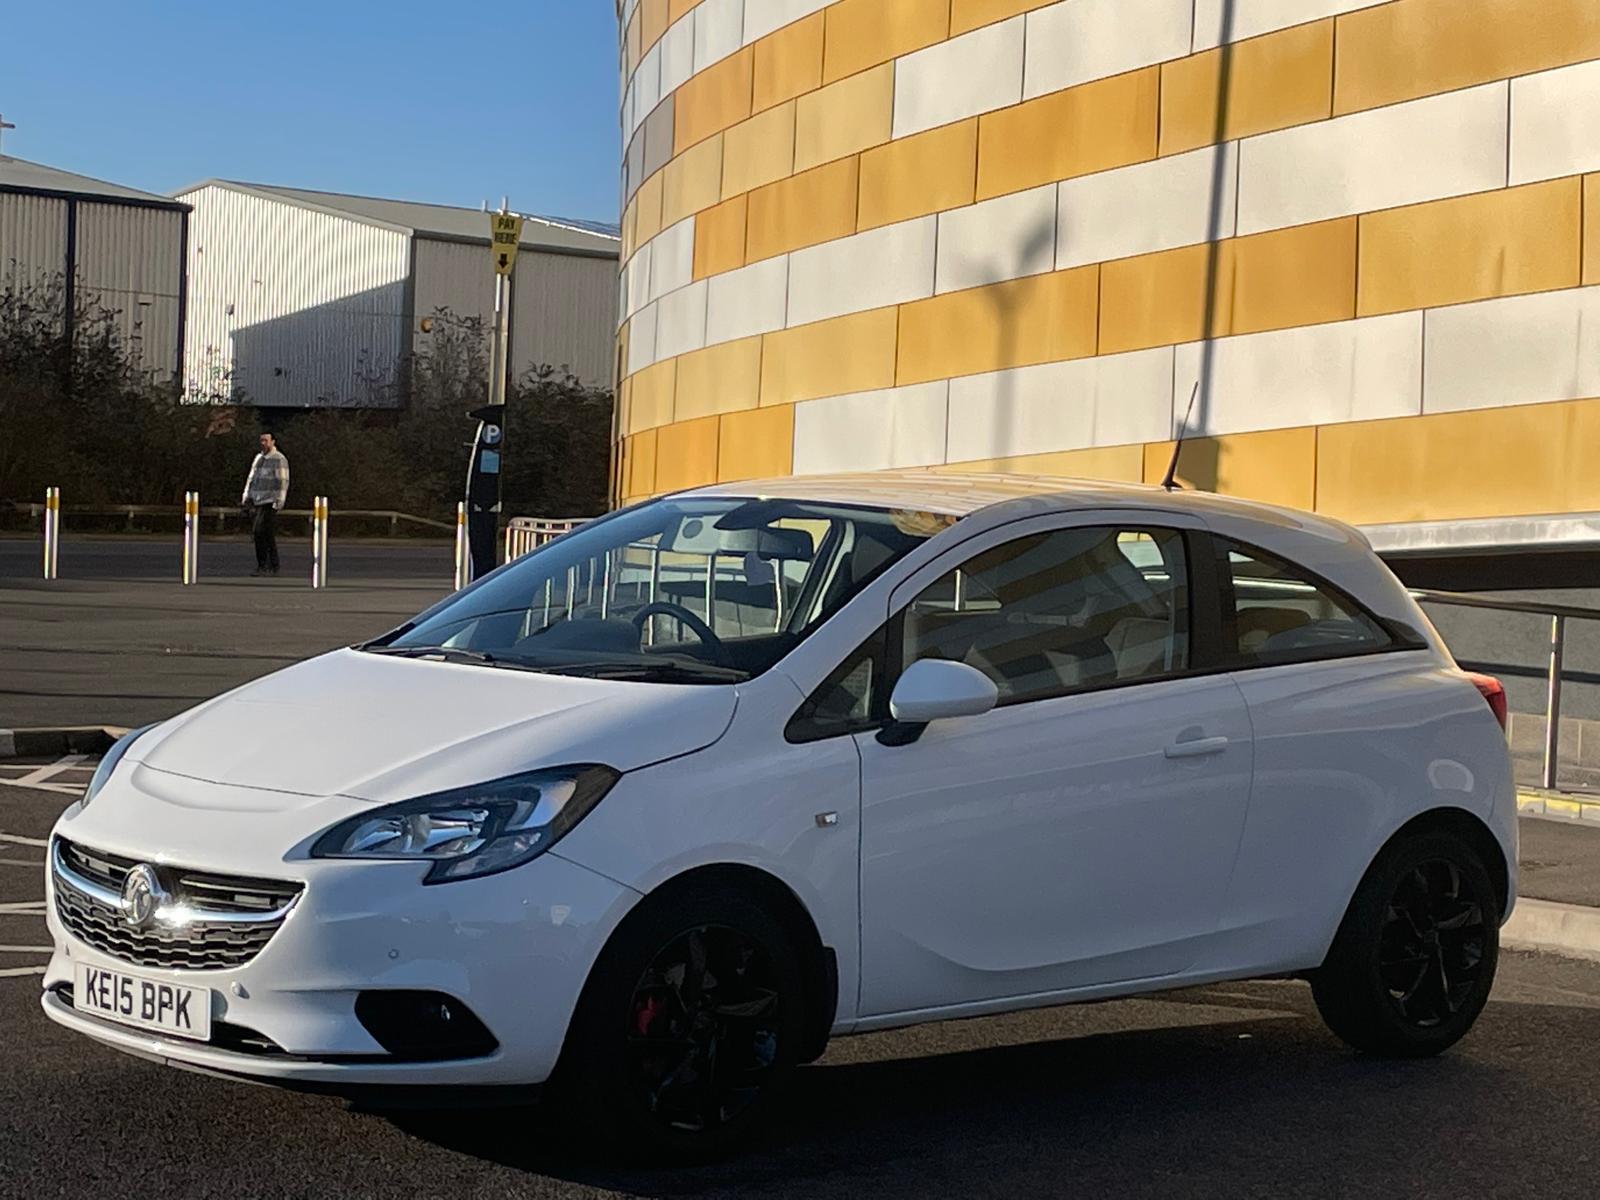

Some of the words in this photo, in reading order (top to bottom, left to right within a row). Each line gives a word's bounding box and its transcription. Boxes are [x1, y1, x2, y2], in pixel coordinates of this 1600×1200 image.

[498, 217, 515, 229] PAY
[487, 424, 500, 443] P
[86, 967, 133, 1015] KE15
[141, 981, 192, 1029] BPK
